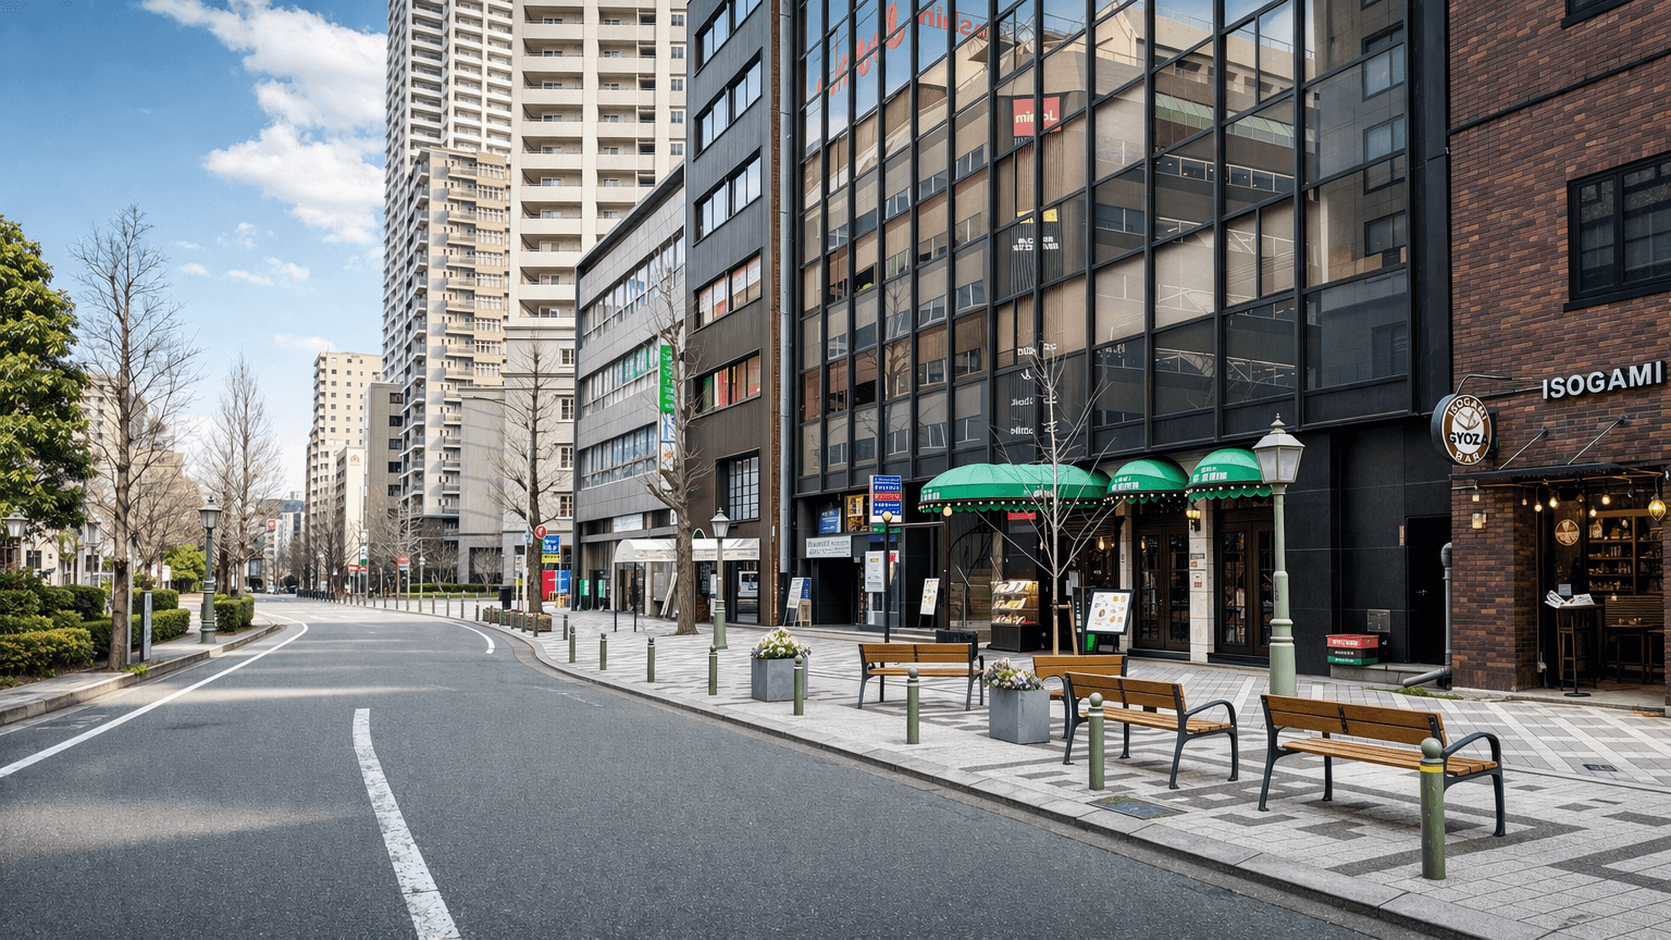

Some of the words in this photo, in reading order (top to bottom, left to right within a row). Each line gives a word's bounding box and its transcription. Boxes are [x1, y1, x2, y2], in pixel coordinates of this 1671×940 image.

[1542, 360, 1663, 400] ISOGAMI
[1448, 397, 1487, 420] ISOGAMI
[1448, 432, 1489, 446] GYOZA
[1455, 450, 1480, 463] BAR
